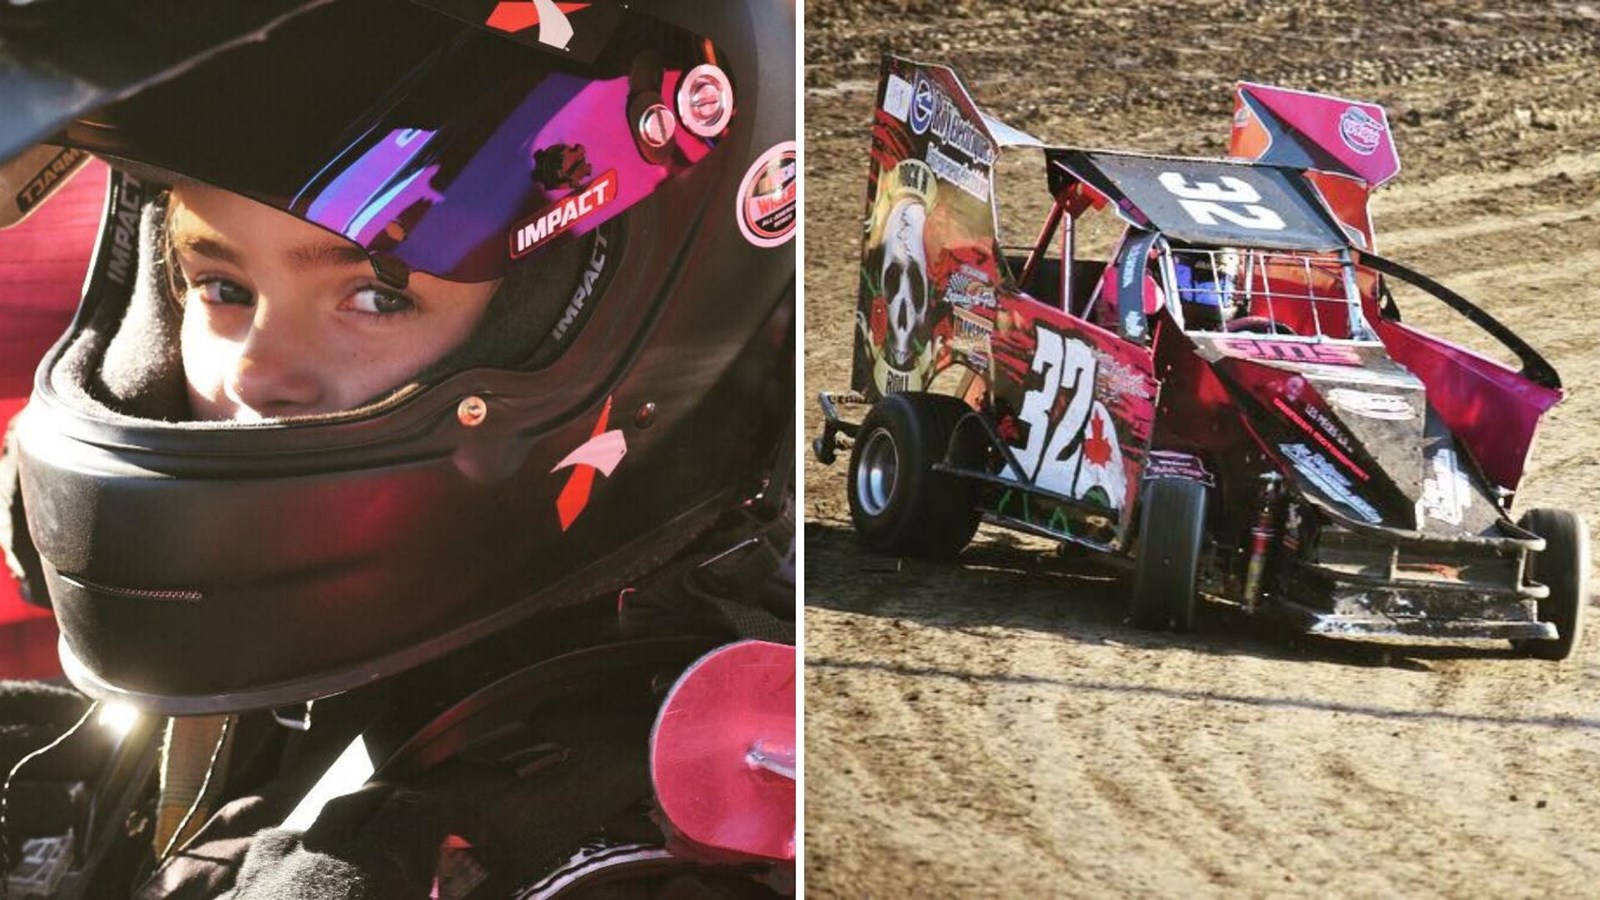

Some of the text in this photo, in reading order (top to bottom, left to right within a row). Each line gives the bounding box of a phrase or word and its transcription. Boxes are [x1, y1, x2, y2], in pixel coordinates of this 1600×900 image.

[106, 170, 141, 285] IMPACT
[517, 179, 609, 252] IMPACT
[1157, 171, 1287, 231] 32
[551, 226, 608, 341] IMPACT
[998, 325, 1127, 510] 32
